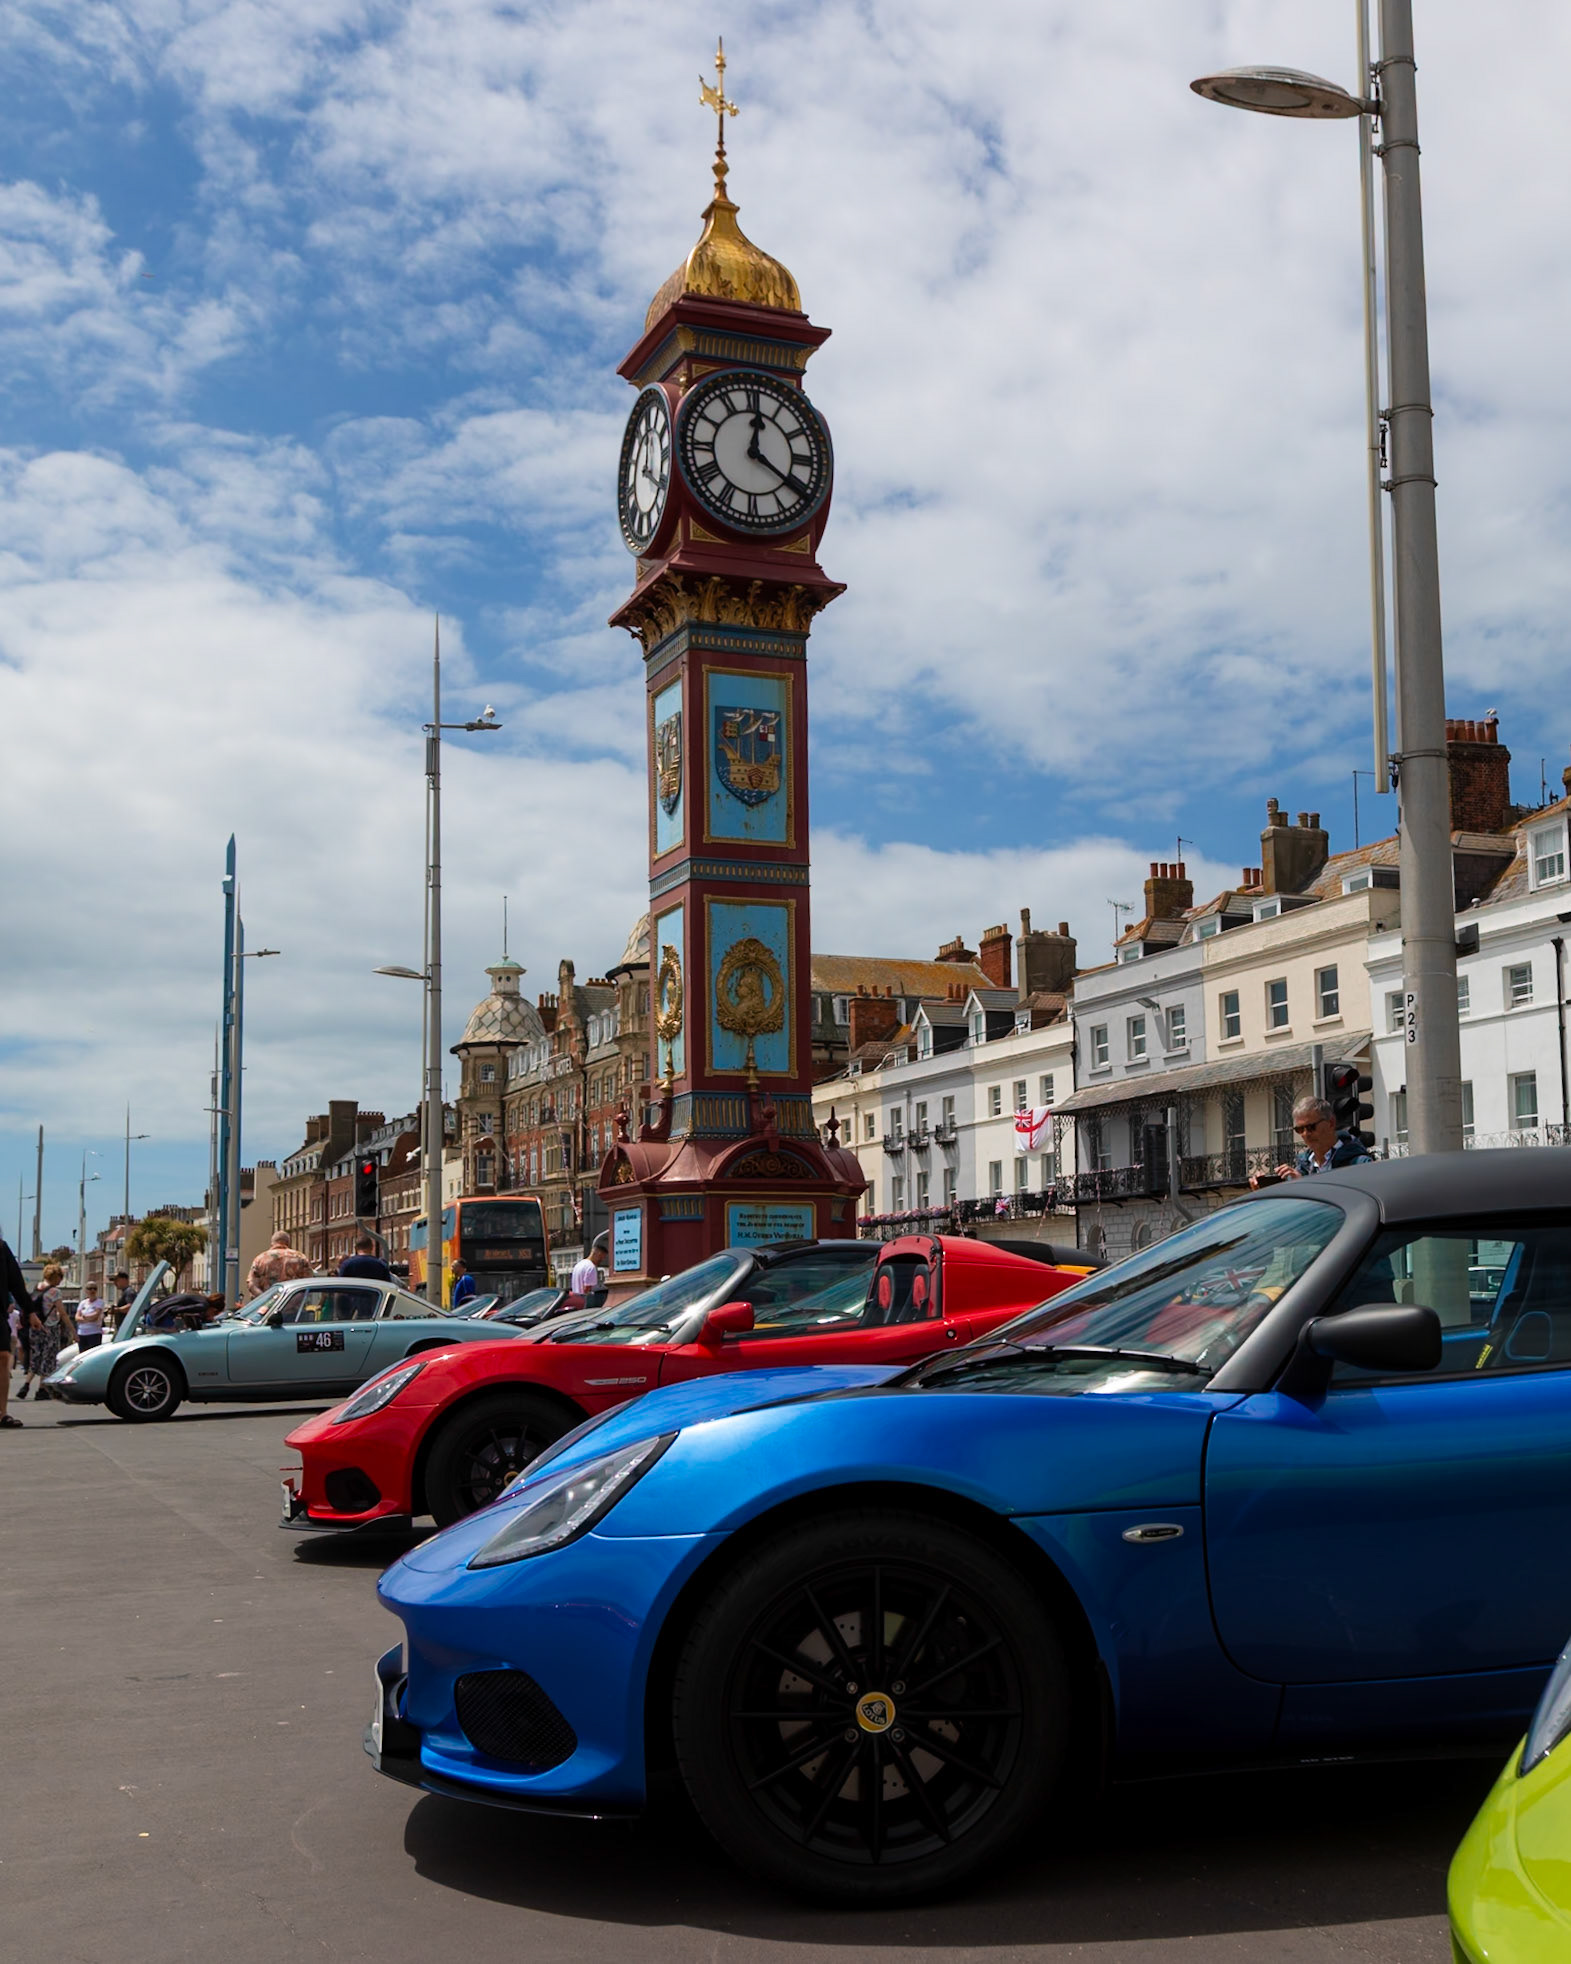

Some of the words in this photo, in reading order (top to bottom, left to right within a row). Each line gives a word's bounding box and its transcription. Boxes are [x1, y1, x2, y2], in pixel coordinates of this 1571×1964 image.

[791, 453, 813, 467] III
[1407, 994, 1416, 1043] P23
[315, 1332, 332, 1348] 46
[862, 1704, 886, 1725] LOTUS
